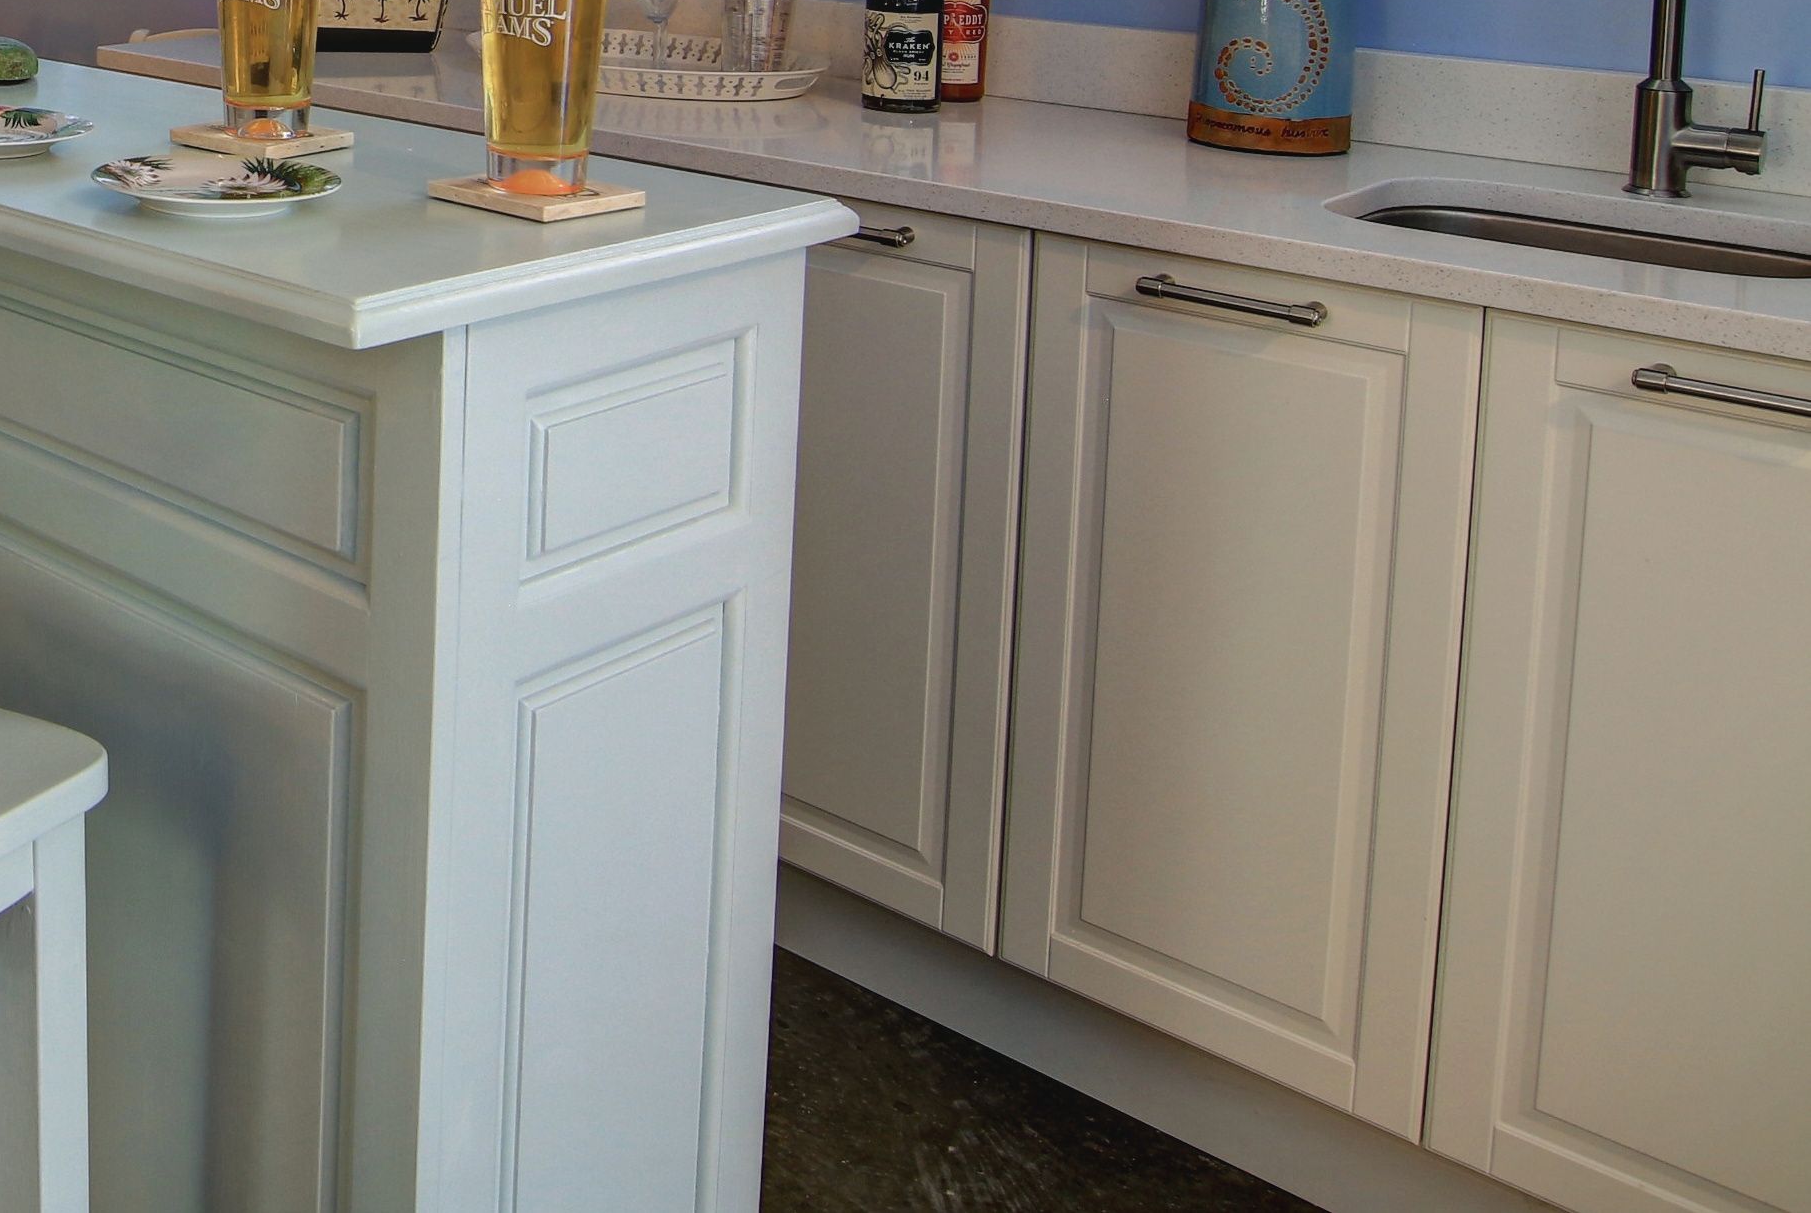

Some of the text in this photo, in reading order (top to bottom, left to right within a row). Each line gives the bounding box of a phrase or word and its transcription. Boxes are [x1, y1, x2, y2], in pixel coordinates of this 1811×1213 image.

[959, 15, 983, 25] EDDY
[888, 42, 930, 50] KRAKEN
[914, 71, 929, 81] 94
